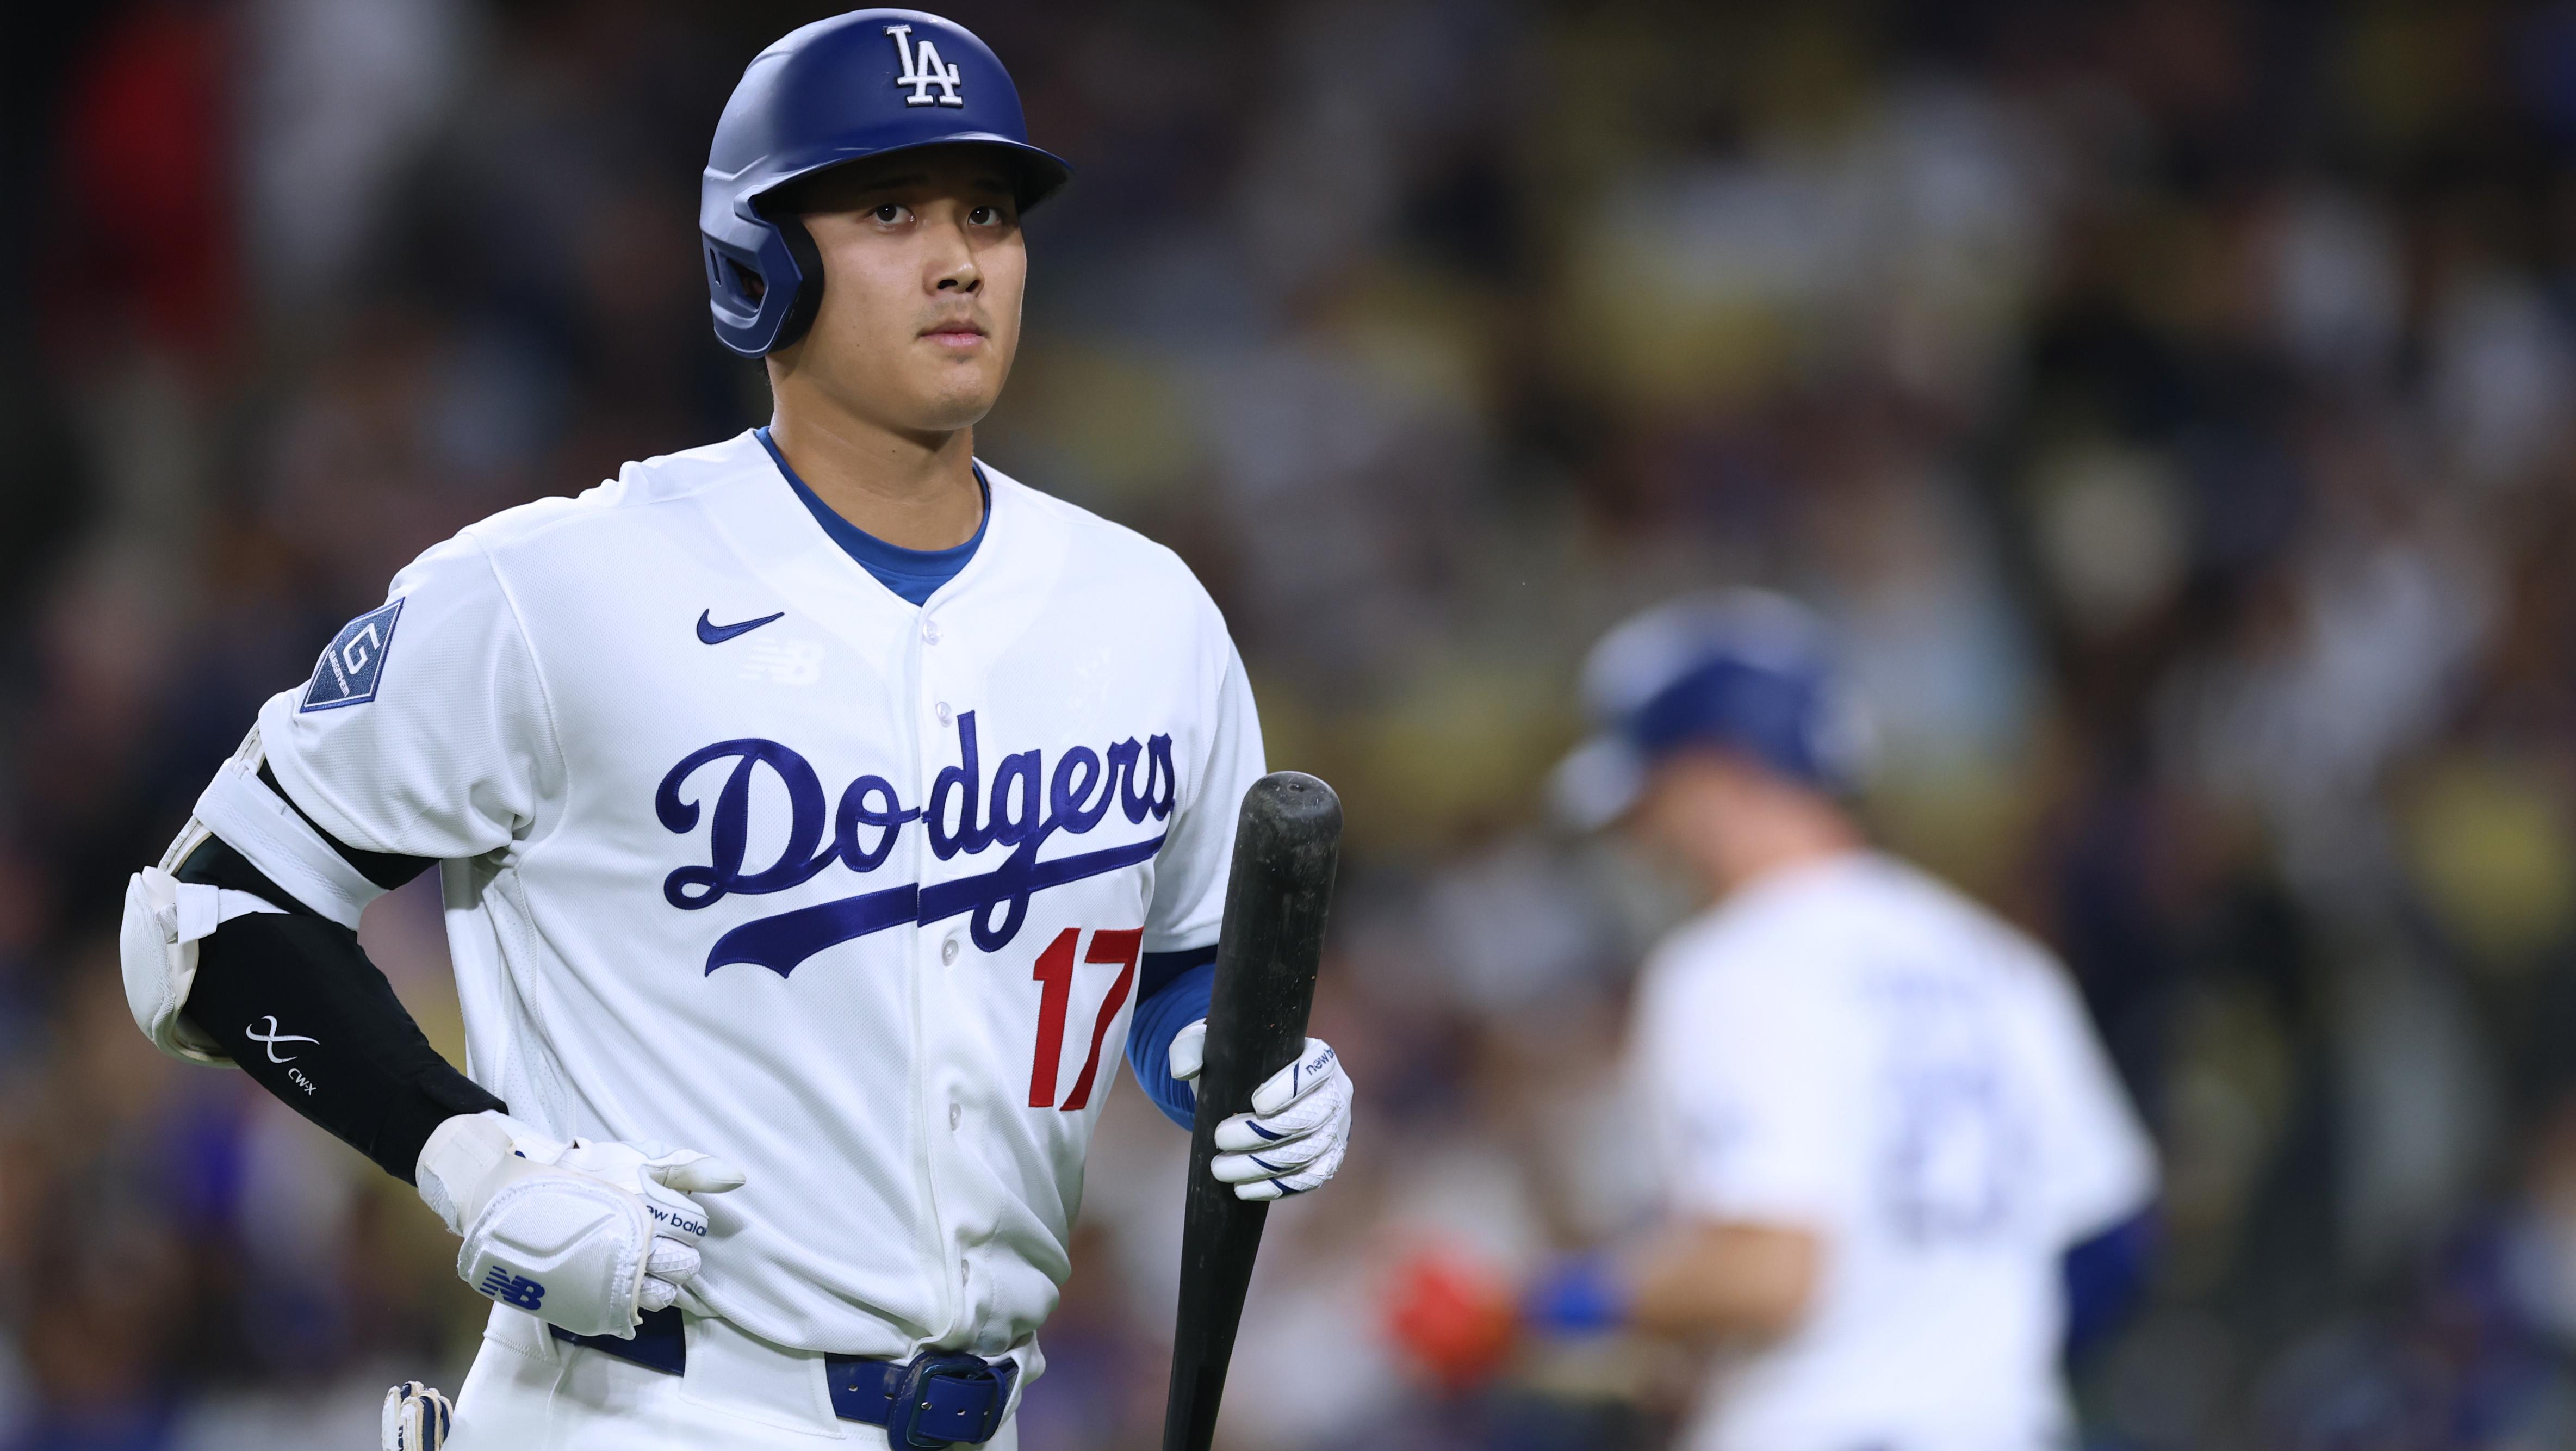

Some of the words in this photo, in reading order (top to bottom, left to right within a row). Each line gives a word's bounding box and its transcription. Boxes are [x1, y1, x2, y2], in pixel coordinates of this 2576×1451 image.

[884, 24, 963, 108] LA
[655, 710, 1176, 952] Dodgers
[1028, 927, 1144, 1111] 17
[288, 1068, 317, 1096] CW-X
[1306, 1052, 1329, 1076] new
[646, 1205, 668, 1221] ew
[671, 1213, 707, 1237] bala
[479, 1265, 545, 1311] NB
